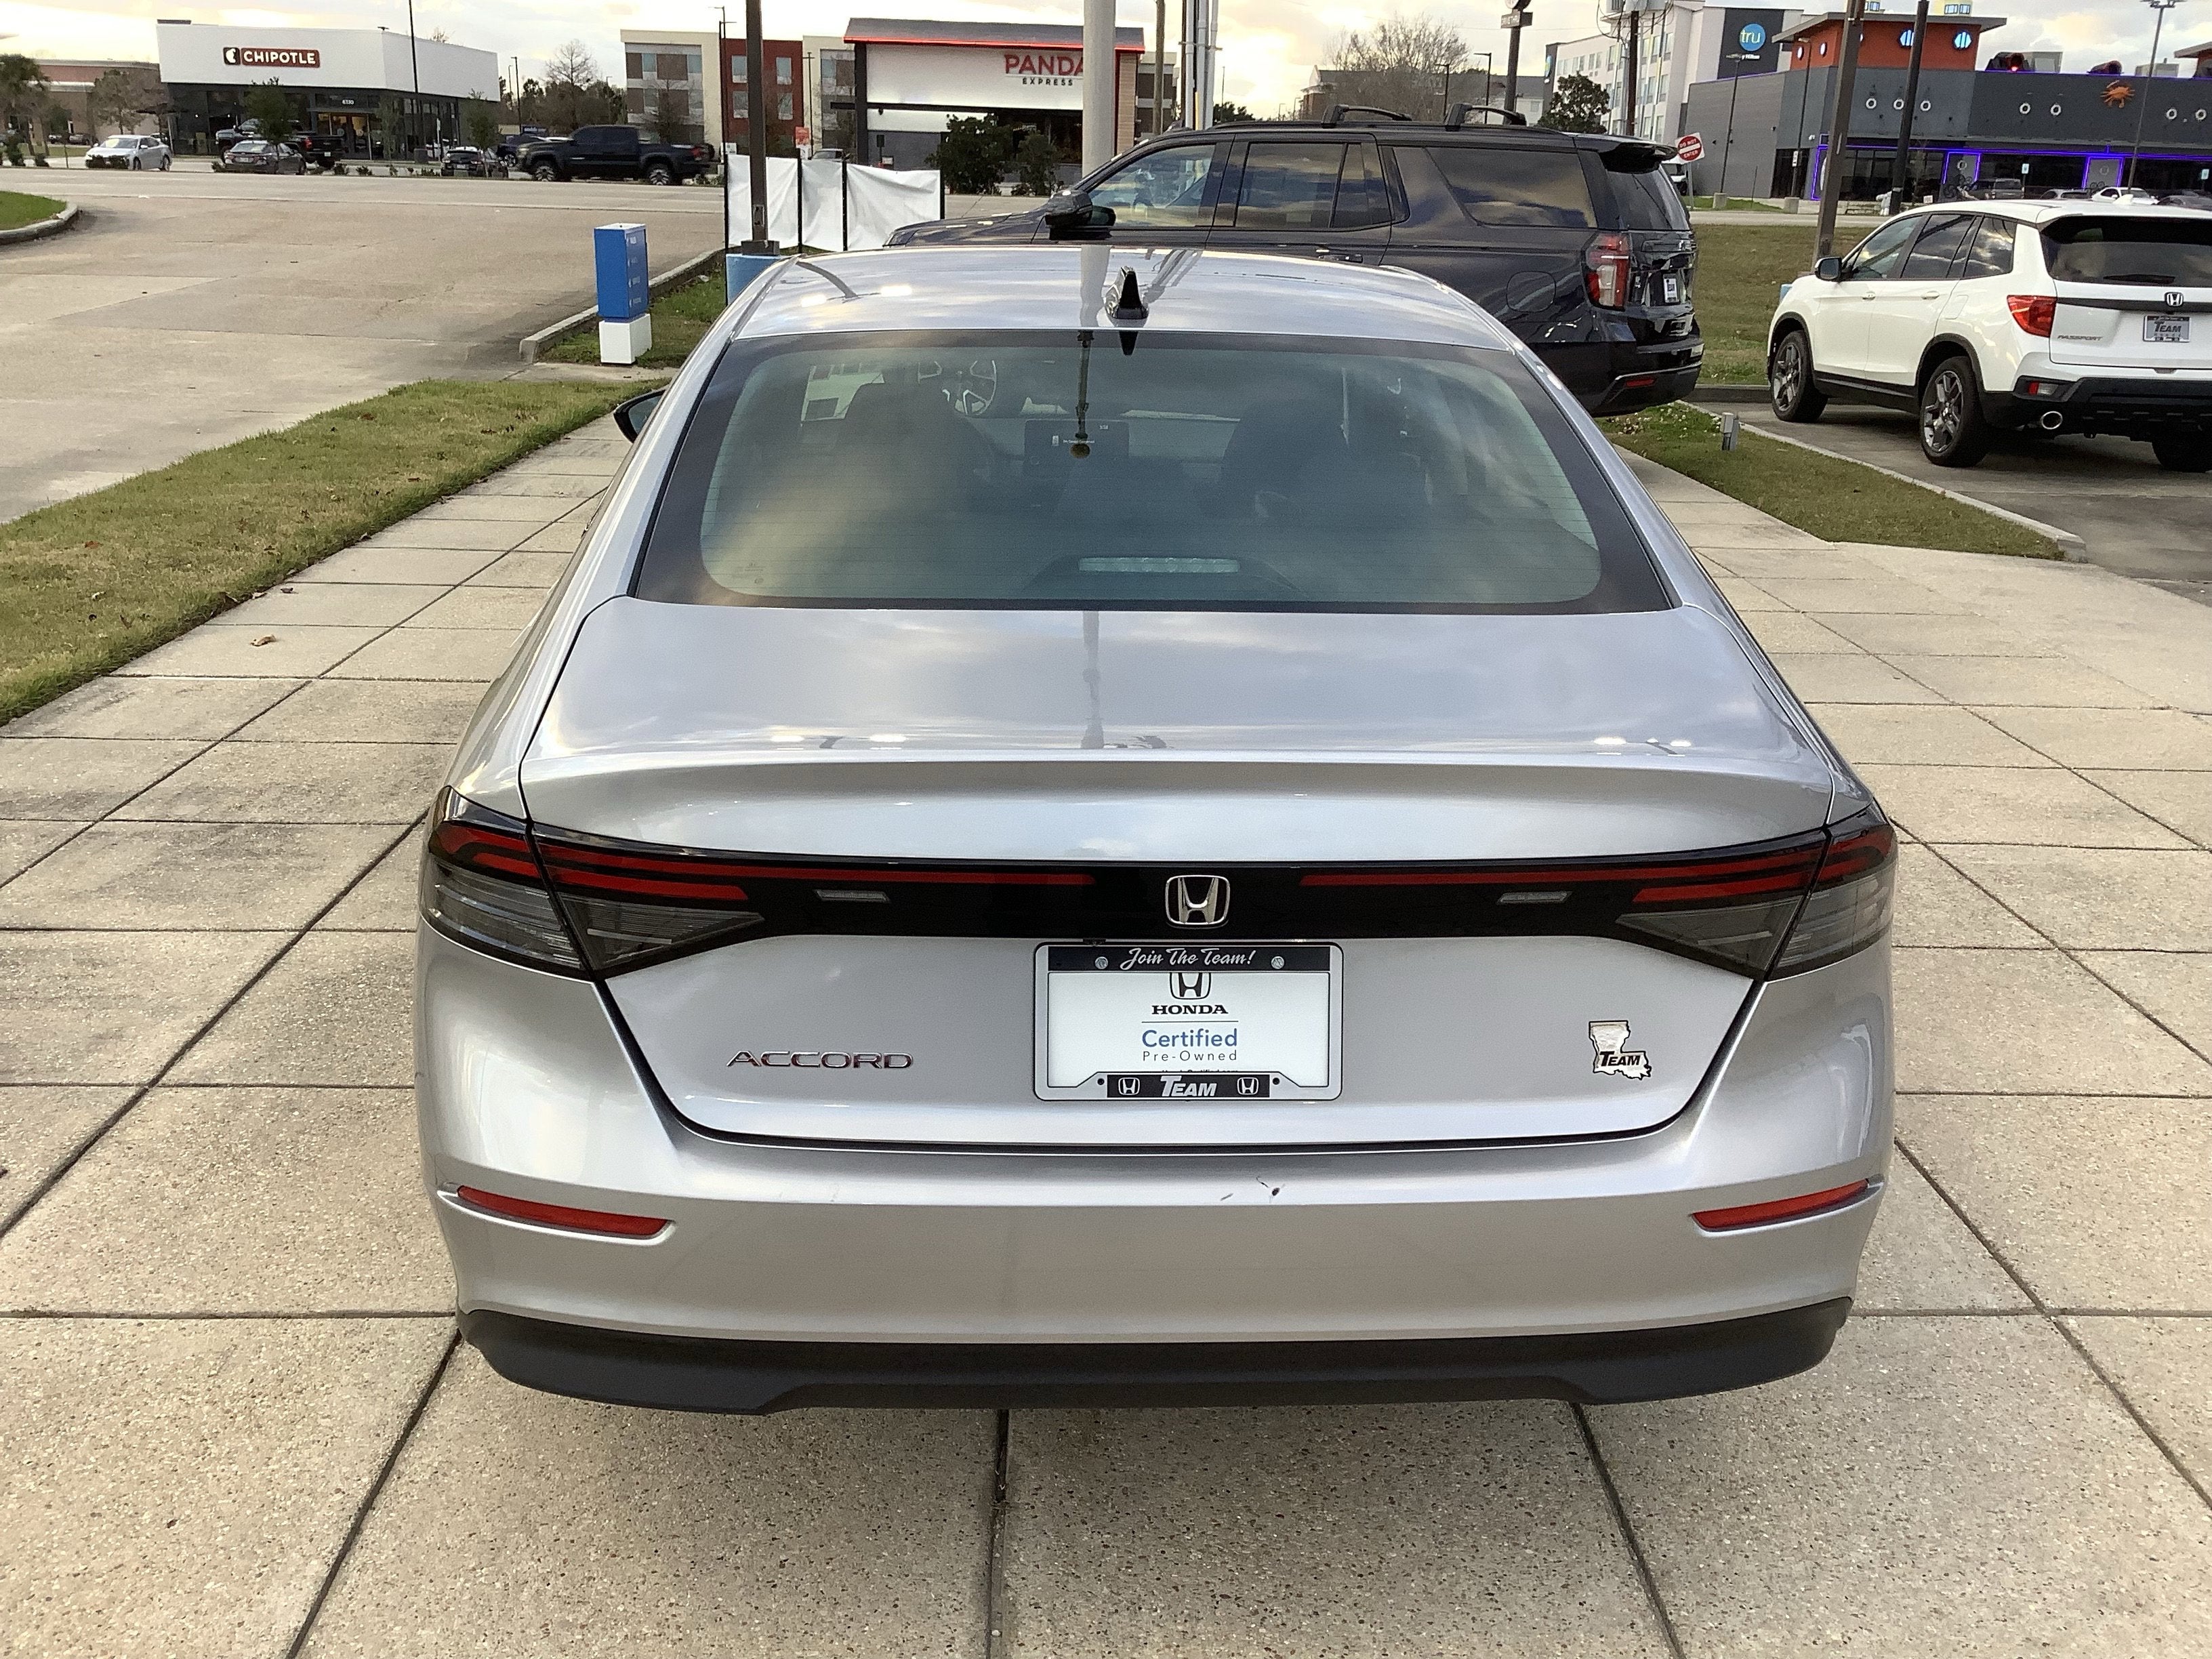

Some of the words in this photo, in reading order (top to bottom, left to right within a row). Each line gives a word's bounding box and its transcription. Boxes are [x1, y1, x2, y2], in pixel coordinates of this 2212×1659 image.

[1740, 29, 1761, 43] tru
[243, 51, 316, 64] CHIPOTLE
[1022, 77, 1073, 86] EXPRESS
[1120, 947, 1164, 970] Join
[1166, 947, 1198, 965] The
[1201, 947, 1256, 965] Team!
[1151, 1004, 1229, 1015] HONDA
[1142, 1028, 1237, 1047] Certified
[726, 1050, 913, 1069] ACCORD
[1143, 1050, 1237, 1061] Pre-Owned
[1599, 1051, 1641, 1067] TEAM
[1160, 1076, 1217, 1097] TEAM
